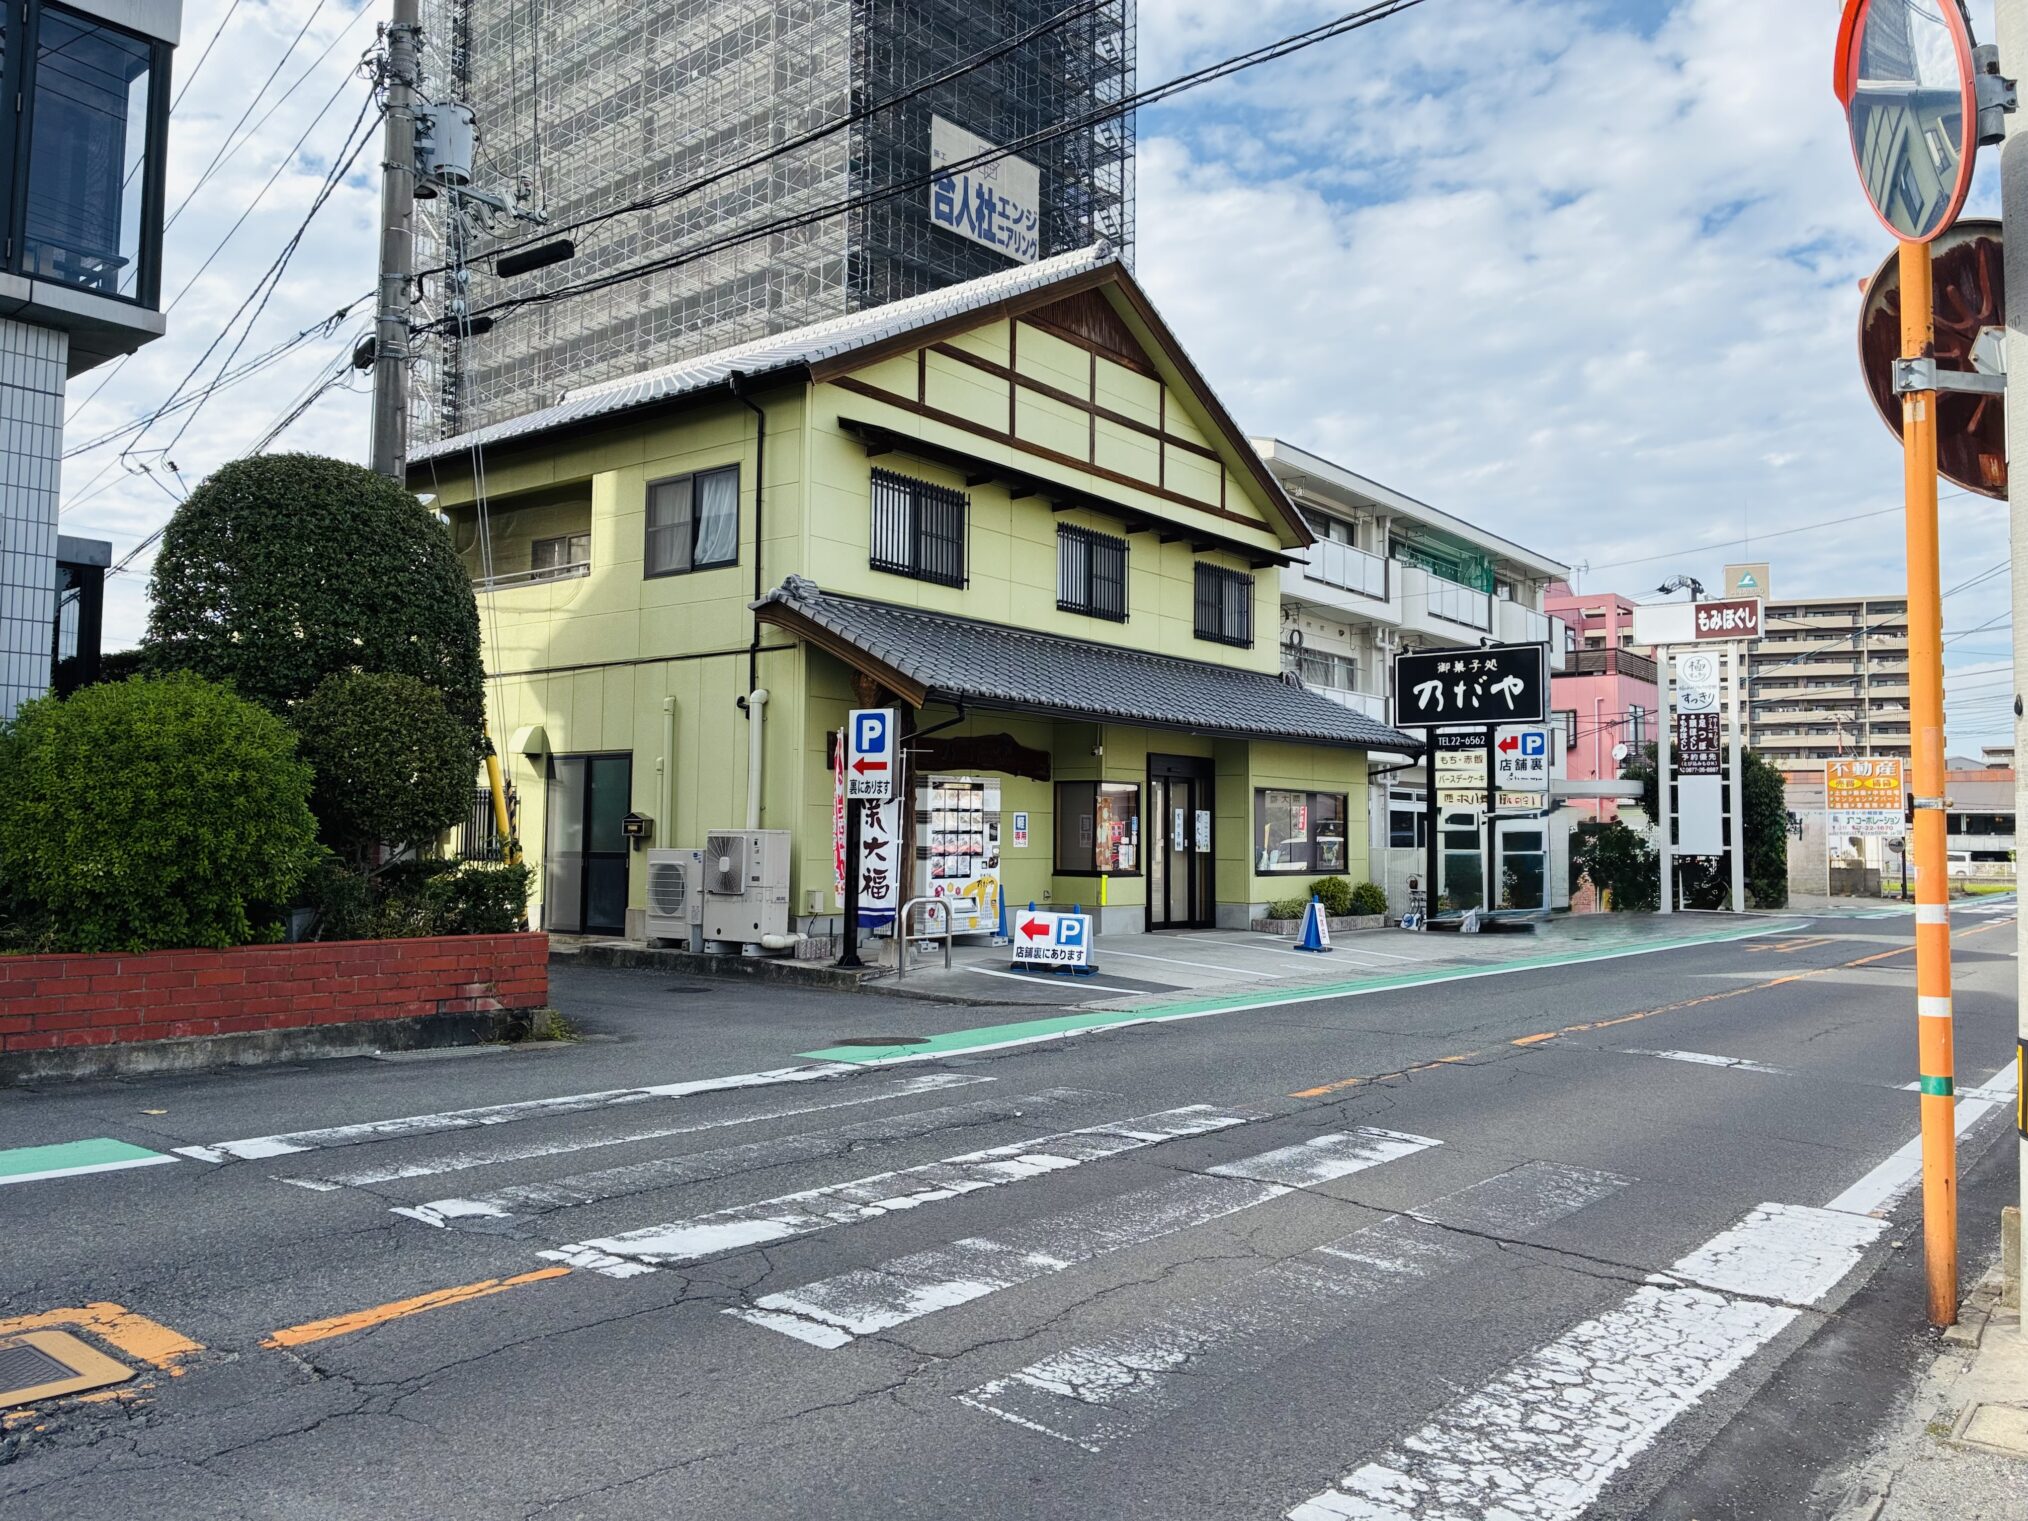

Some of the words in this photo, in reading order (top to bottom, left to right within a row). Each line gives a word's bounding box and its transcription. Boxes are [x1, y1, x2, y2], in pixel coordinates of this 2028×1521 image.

[998, 196, 1037, 231] エンジ
[997, 224, 1037, 260] ニアリング
[1698, 607, 1756, 631] もみほぐし
[1437, 659, 1498, 673] 御菓子処
[1413, 675, 1524, 711] 乃だや
[862, 719, 883, 750] P
[1438, 736, 1485, 746] TEL22-6562
[1526, 736, 1542, 754] P
[1441, 755, 1483, 764] もち・赤飯
[1500, 758, 1543, 771] 店舗裏
[1829, 761, 1897, 777] 不動産
[849, 779, 890, 795] 裏にあります
[1438, 775, 1485, 784] バースデーケーキ
[1060, 920, 1081, 943] P
[1015, 946, 1084, 962] 店舗裏にあります
